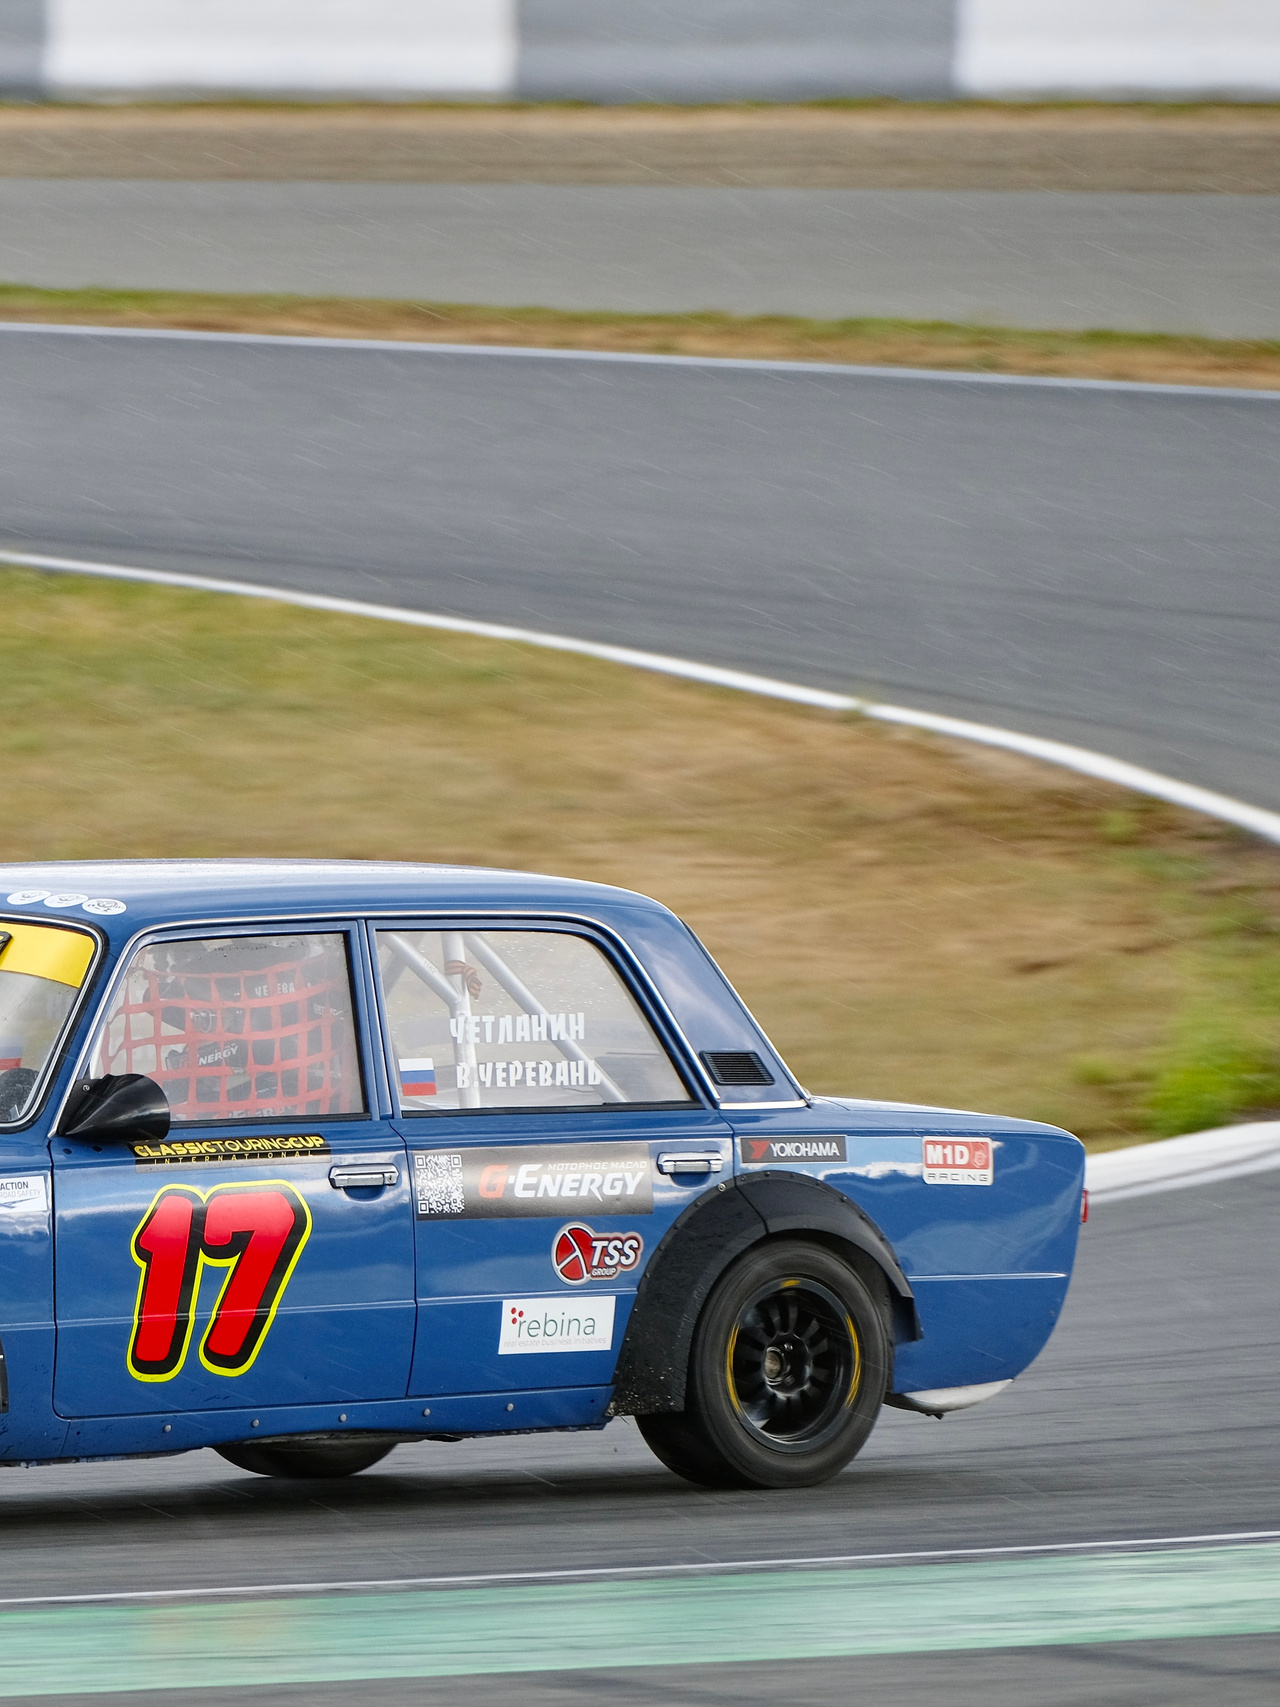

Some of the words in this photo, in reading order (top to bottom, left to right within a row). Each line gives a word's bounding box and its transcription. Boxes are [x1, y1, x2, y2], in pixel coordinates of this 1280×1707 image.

[449, 1012, 585, 1044] ЧЕТЛАНИН
[197, 1045, 238, 1066] NERGY
[770, 1140, 840, 1157] YOKOHAMA
[926, 1144, 970, 1165] M1D
[154, 1151, 314, 1165] INTERNATIONAL
[547, 1162, 608, 1171] МОТОРНОЕ
[609, 1160, 648, 1170] МАСЛО
[926, 1172, 989, 1182] RACING
[0, 1181, 29, 1191] ACTION
[0, 1191, 16, 1199] ROAD
[17, 1189, 42, 1198] SAFETY
[590, 1238, 639, 1267] TSS
[130, 1183, 309, 1376] 17
[590, 1267, 617, 1277] GROUP
[517, 1311, 596, 1338] rebina
[503, 1339, 517, 1348] real
[518, 1338, 541, 1347] estate
[541, 1337, 572, 1346] business
